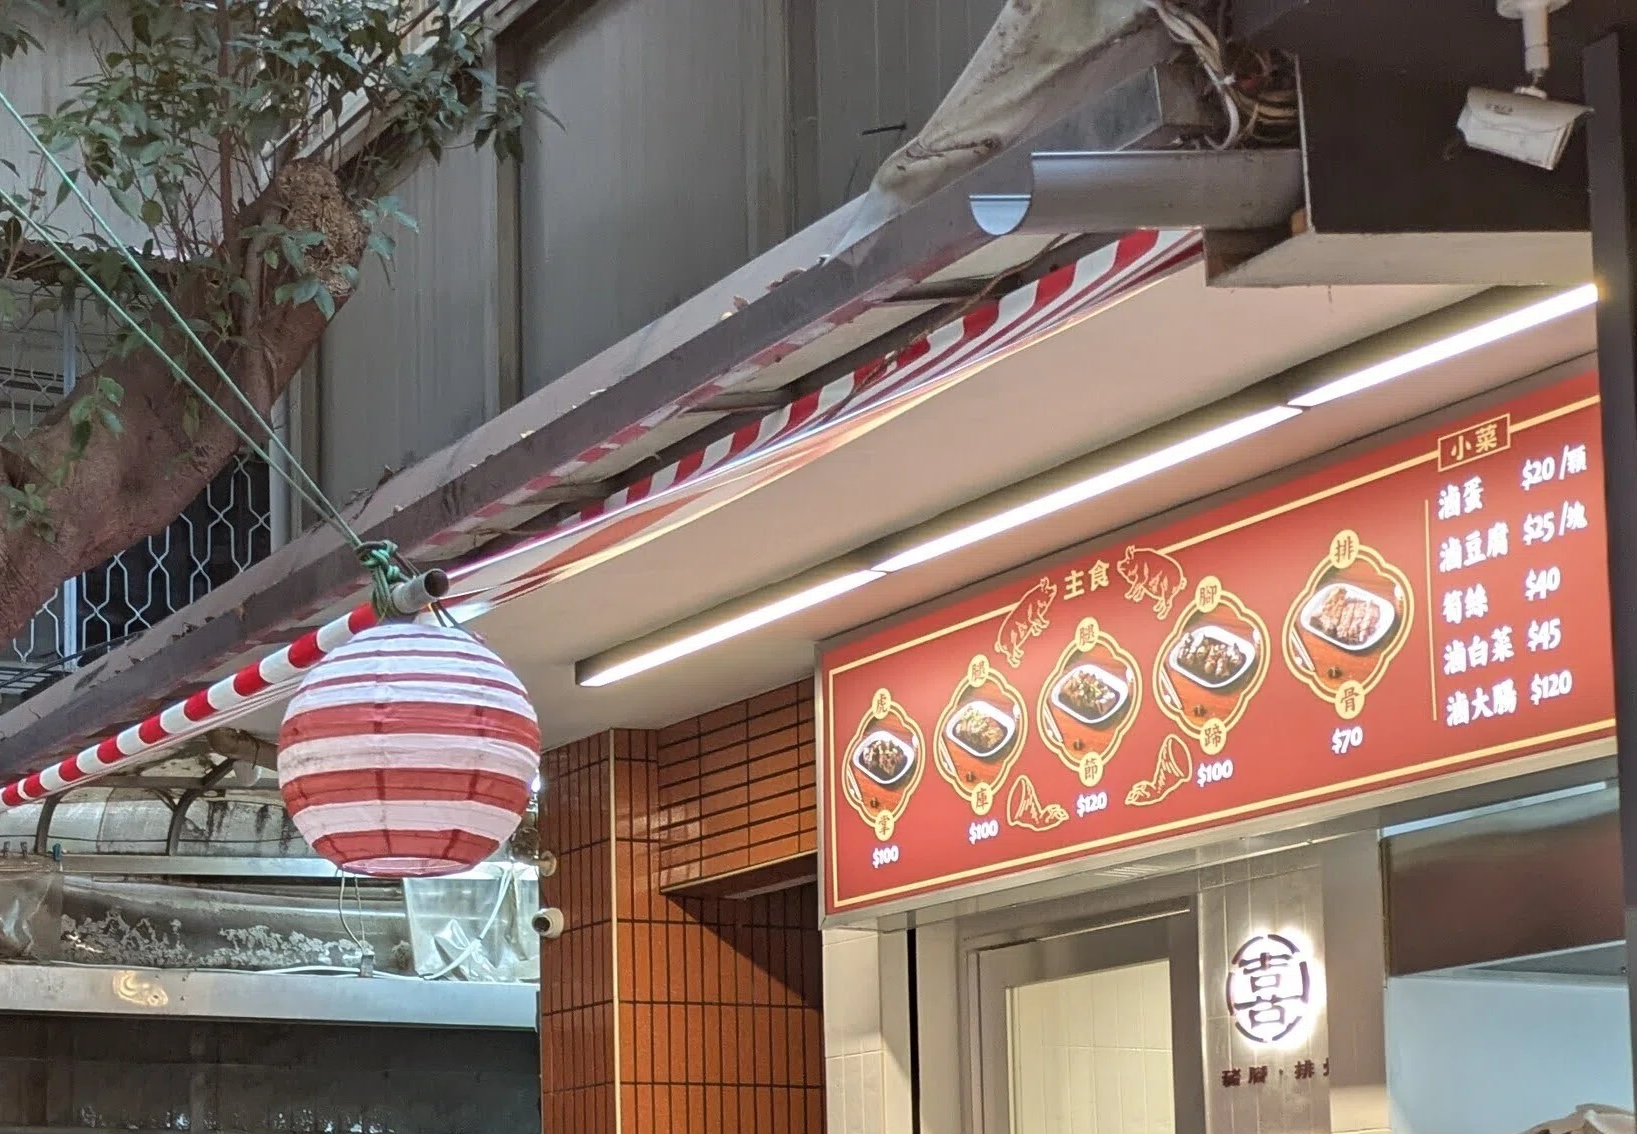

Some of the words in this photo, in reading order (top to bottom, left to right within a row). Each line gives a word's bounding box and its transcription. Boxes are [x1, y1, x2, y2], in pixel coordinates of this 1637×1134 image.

[1450, 423, 1498, 461] 小菜
[1438, 475, 1484, 520] 滷蛋
[1520, 456, 1556, 491] $20
[1439, 521, 1509, 573] 滷豆腐
[1522, 511, 1556, 546] $25
[1063, 559, 1111, 601] 主食
[1442, 583, 1489, 624] 筍絲
[1524, 566, 1561, 601] $40
[1443, 625, 1515, 675] 滷白菜
[1527, 617, 1561, 652] $45
[1446, 678, 1517, 727] 滷大腸
[1530, 669, 1573, 706] $120
[1331, 725, 1364, 754] $70
[1196, 759, 1234, 788] $100
[1076, 791, 1108, 818] $120
[968, 819, 999, 845] $100
[872, 845, 899, 869] $100
